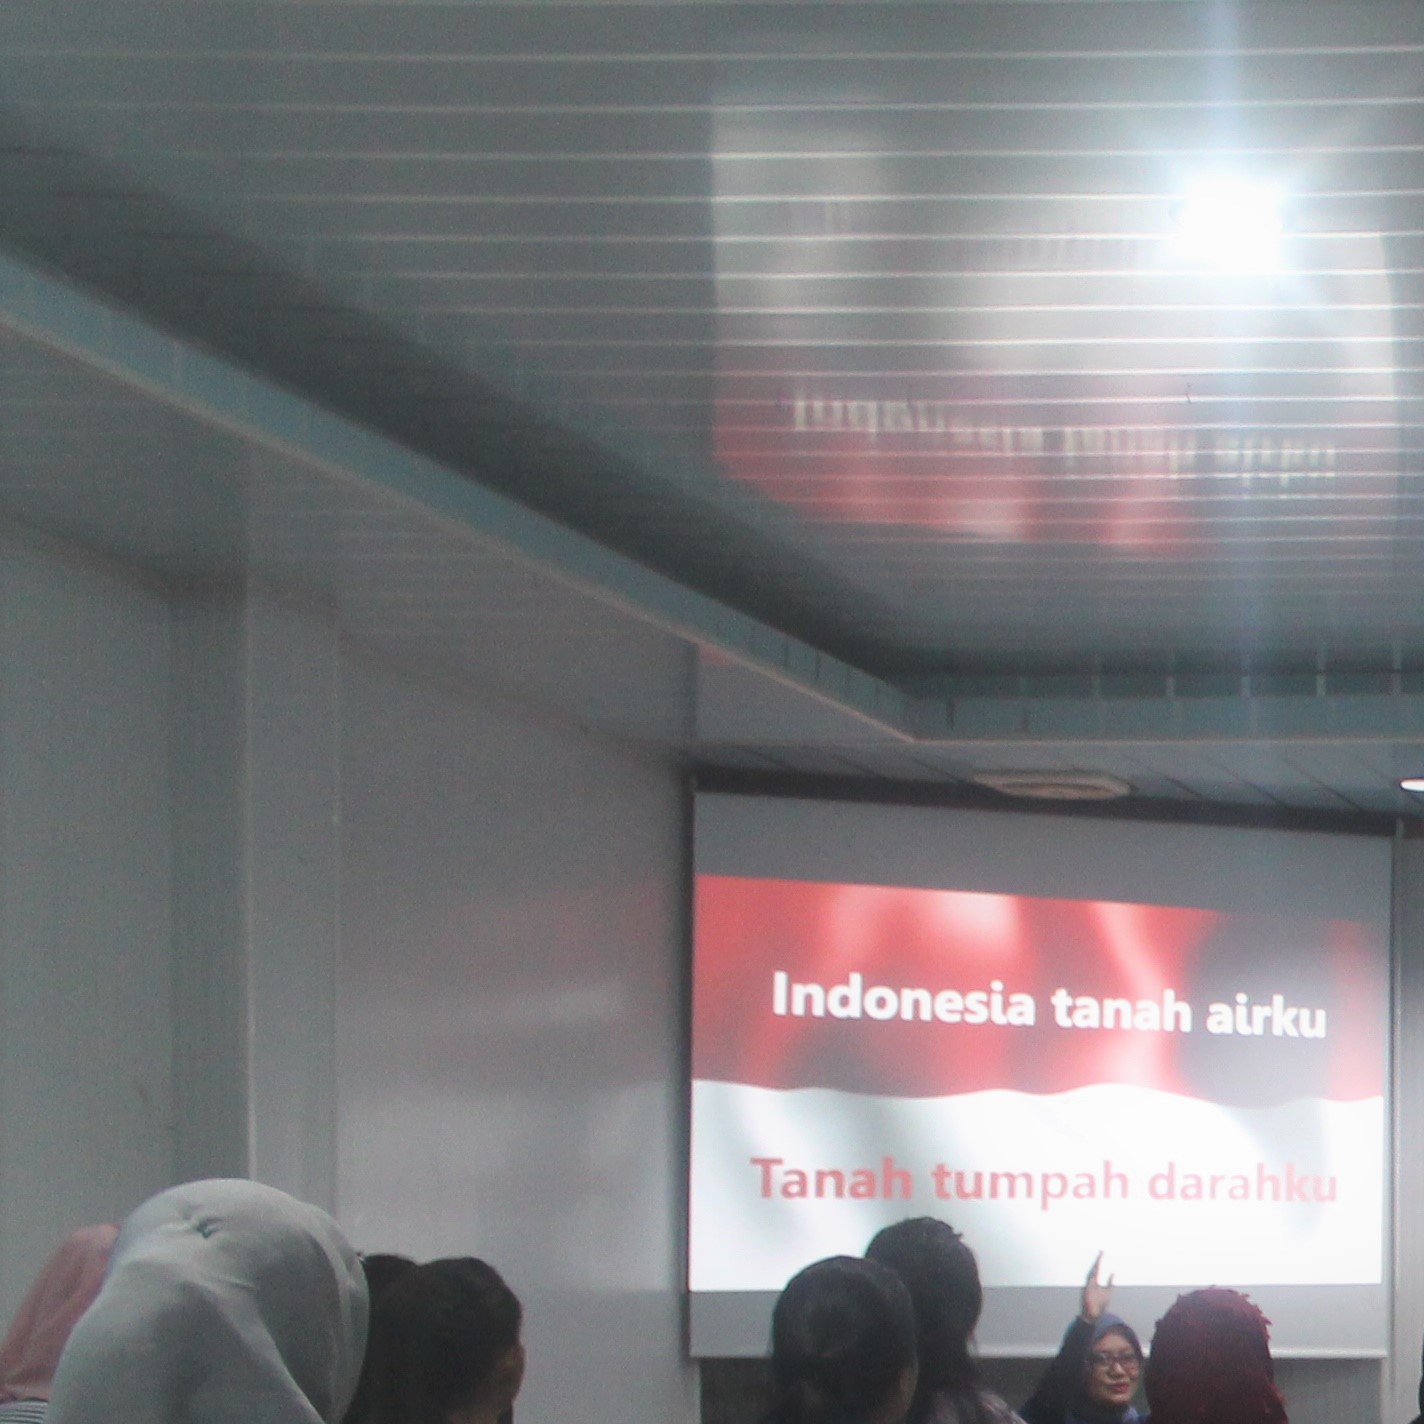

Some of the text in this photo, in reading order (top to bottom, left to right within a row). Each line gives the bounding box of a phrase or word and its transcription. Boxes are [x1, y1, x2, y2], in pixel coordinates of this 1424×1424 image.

[772, 970, 1327, 1039] Indonesia tanah airku
[750, 1156, 1339, 1212] Tanah tumpah darahku
